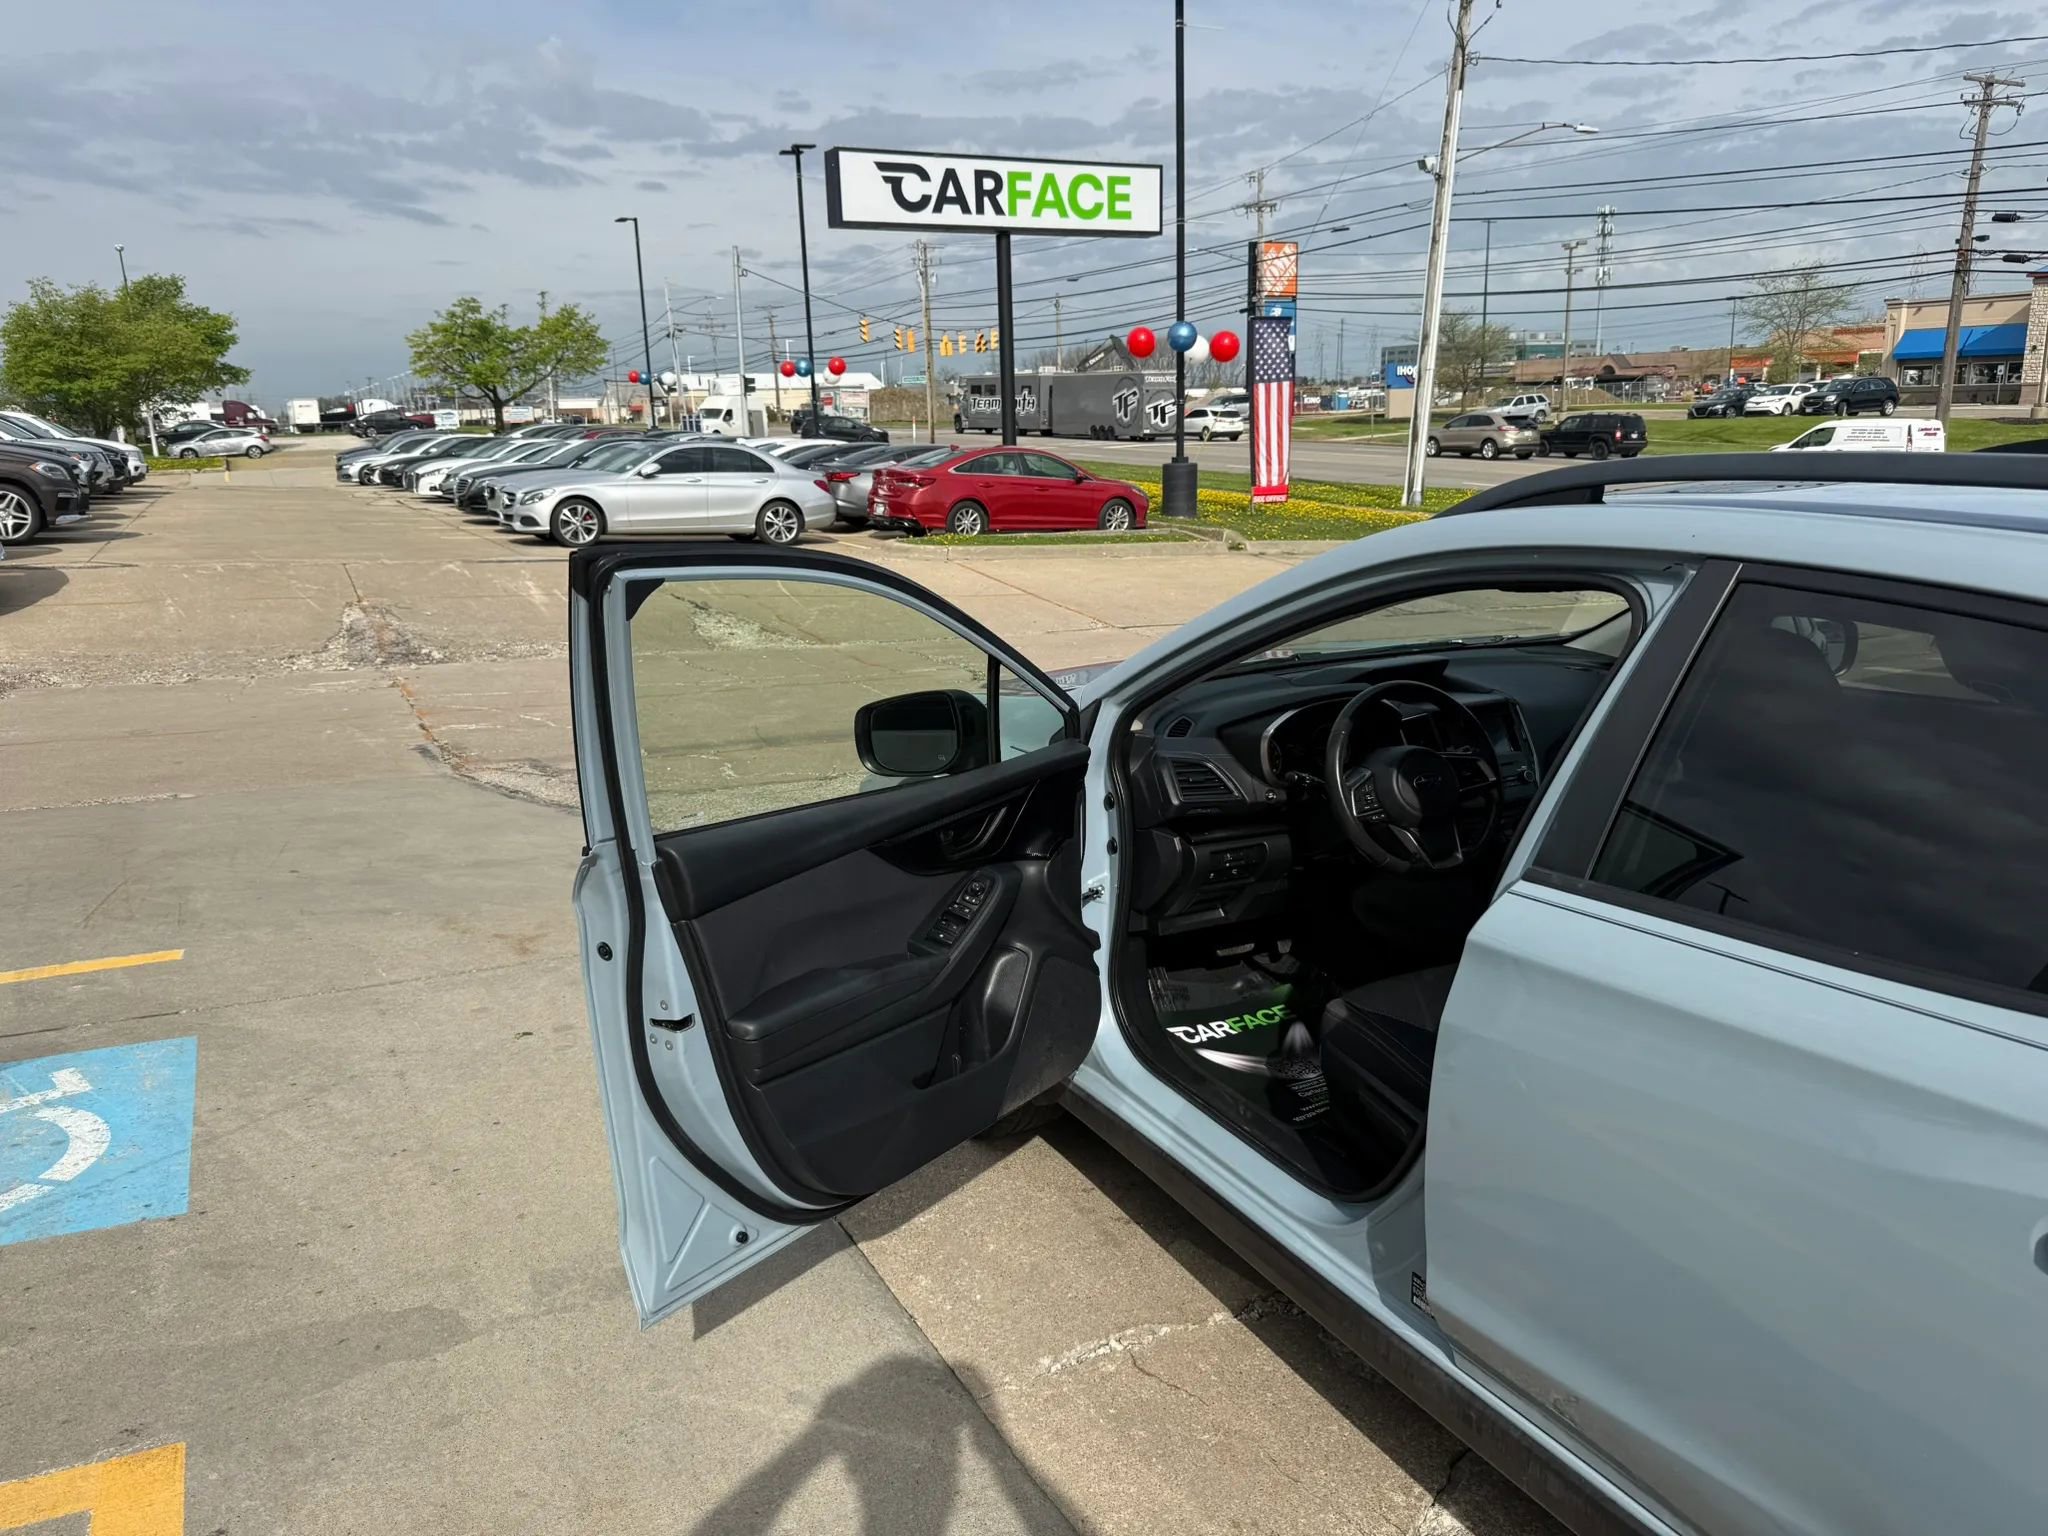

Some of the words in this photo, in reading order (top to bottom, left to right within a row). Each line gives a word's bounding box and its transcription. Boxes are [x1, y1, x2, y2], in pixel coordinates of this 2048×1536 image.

[873, 161, 1132, 220] CARFACE
[1112, 386, 1139, 421] TF
[1166, 1004, 1291, 1043] CARFACE
